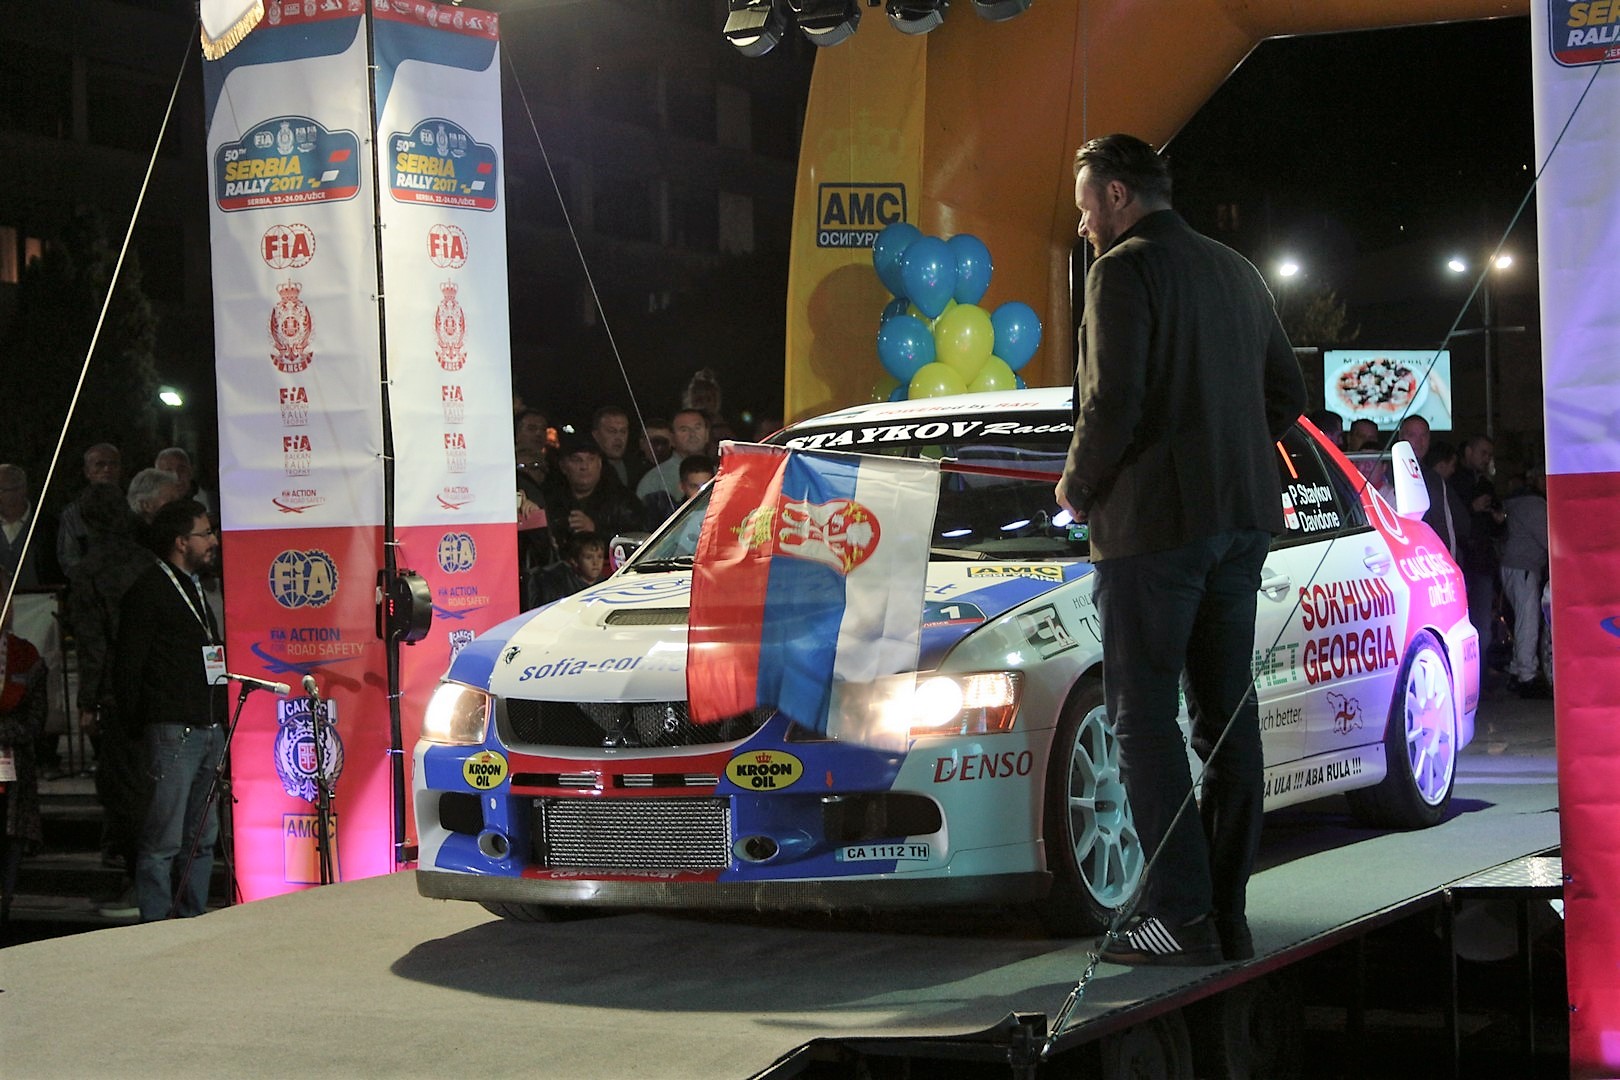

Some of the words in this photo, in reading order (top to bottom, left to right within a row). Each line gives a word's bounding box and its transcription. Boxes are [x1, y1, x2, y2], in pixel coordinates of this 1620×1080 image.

[1567, 25, 1620, 47] RALL
[225, 149, 246, 161] 50TH
[396, 152, 455, 177] SERBIA
[225, 155, 301, 181] SERBIA
[225, 179, 271, 196] RALLY
[270, 176, 304, 192] 2017
[396, 173, 433, 189] RALLY
[432, 177, 458, 192] 2017
[786, 421, 983, 450] STAYKOV
[979, 421, 1074, 436] Racin
[292, 489, 317, 497] ACTION
[450, 586, 478, 596] ACTION
[1300, 578, 1395, 631] SOKHUMI
[290, 628, 340, 641] ACTION
[287, 644, 316, 656] ROAD
[319, 642, 364, 656] SAFETY
[1303, 625, 1398, 685] GEORGIA
[1250, 643, 1299, 688] NET
[469, 764, 501, 776] KROON
[736, 763, 792, 776] KROON
[934, 750, 1033, 783] DENSO
[476, 775, 490, 787] OIL
[752, 776, 776, 788] OIL
[1274, 774, 1291, 796] ULA
[1305, 769, 1324, 787] ABA
[1326, 760, 1350, 782] RULA
[847, 848, 867, 859] CA
[871, 847, 905, 859] 1112
[909, 846, 927, 858] TH
